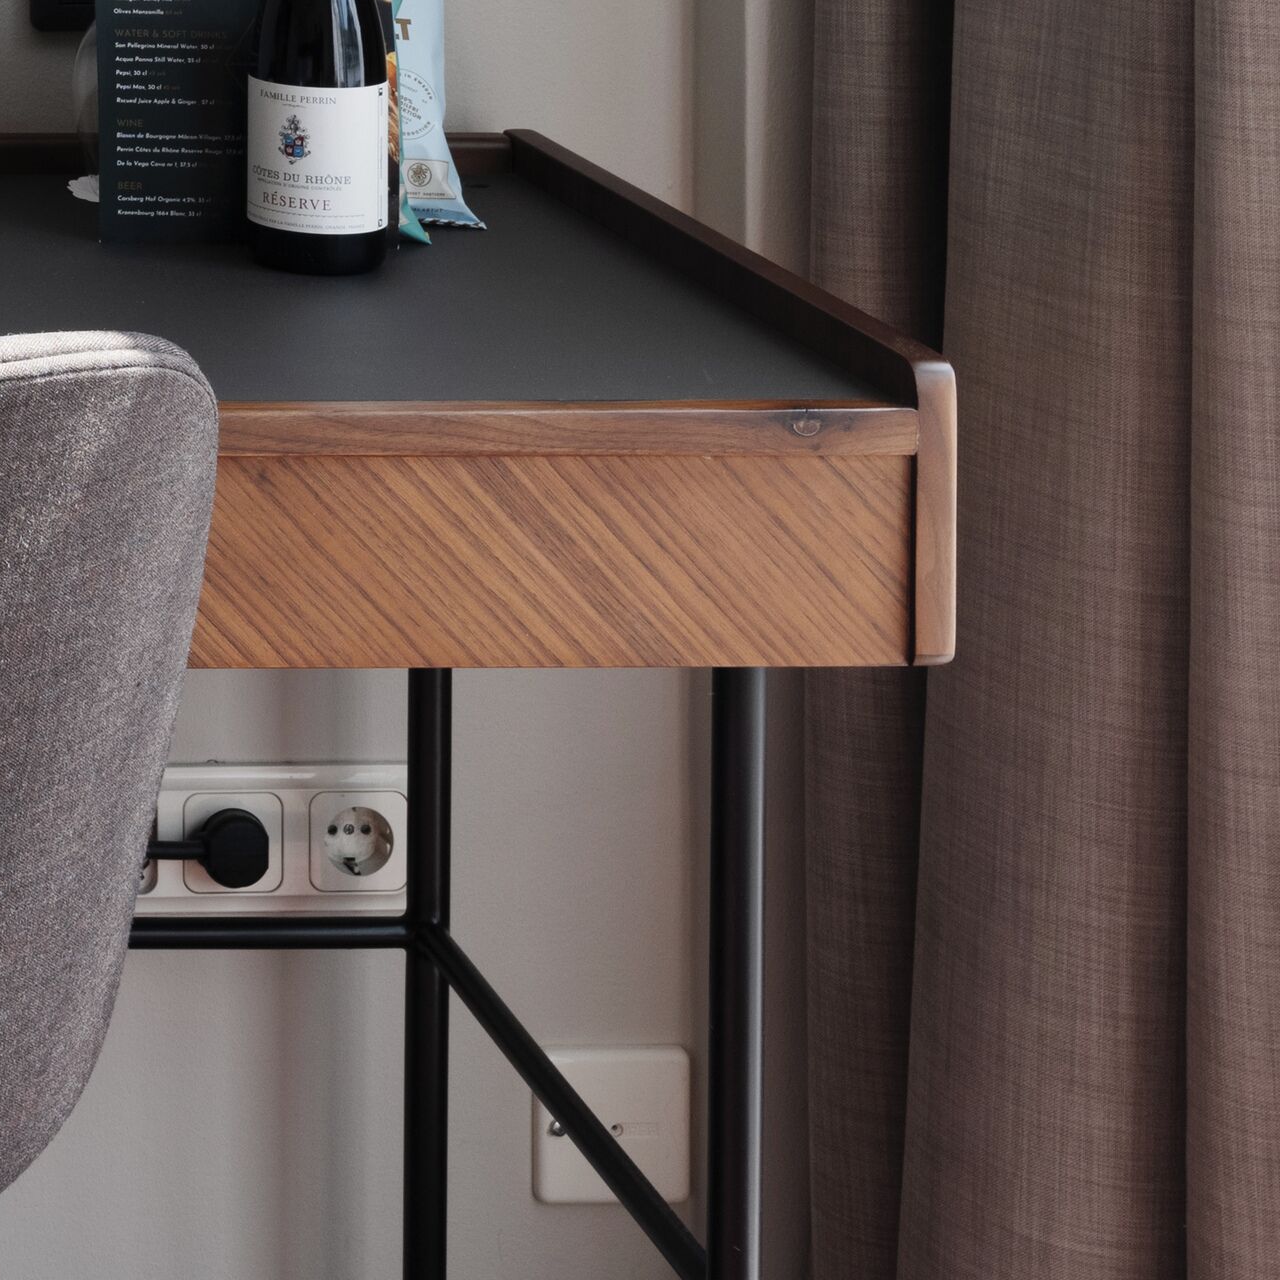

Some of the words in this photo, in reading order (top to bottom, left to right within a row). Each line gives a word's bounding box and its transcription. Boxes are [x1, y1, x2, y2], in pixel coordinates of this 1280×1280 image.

[260, 89, 297, 102] FAMILLE
[300, 96, 336, 105] PERRIN
[253, 165, 280, 178] CÔTES
[284, 172, 300, 180] DU
[305, 174, 351, 185] RHÔNE
[263, 190, 331, 211] RÉSERVE
